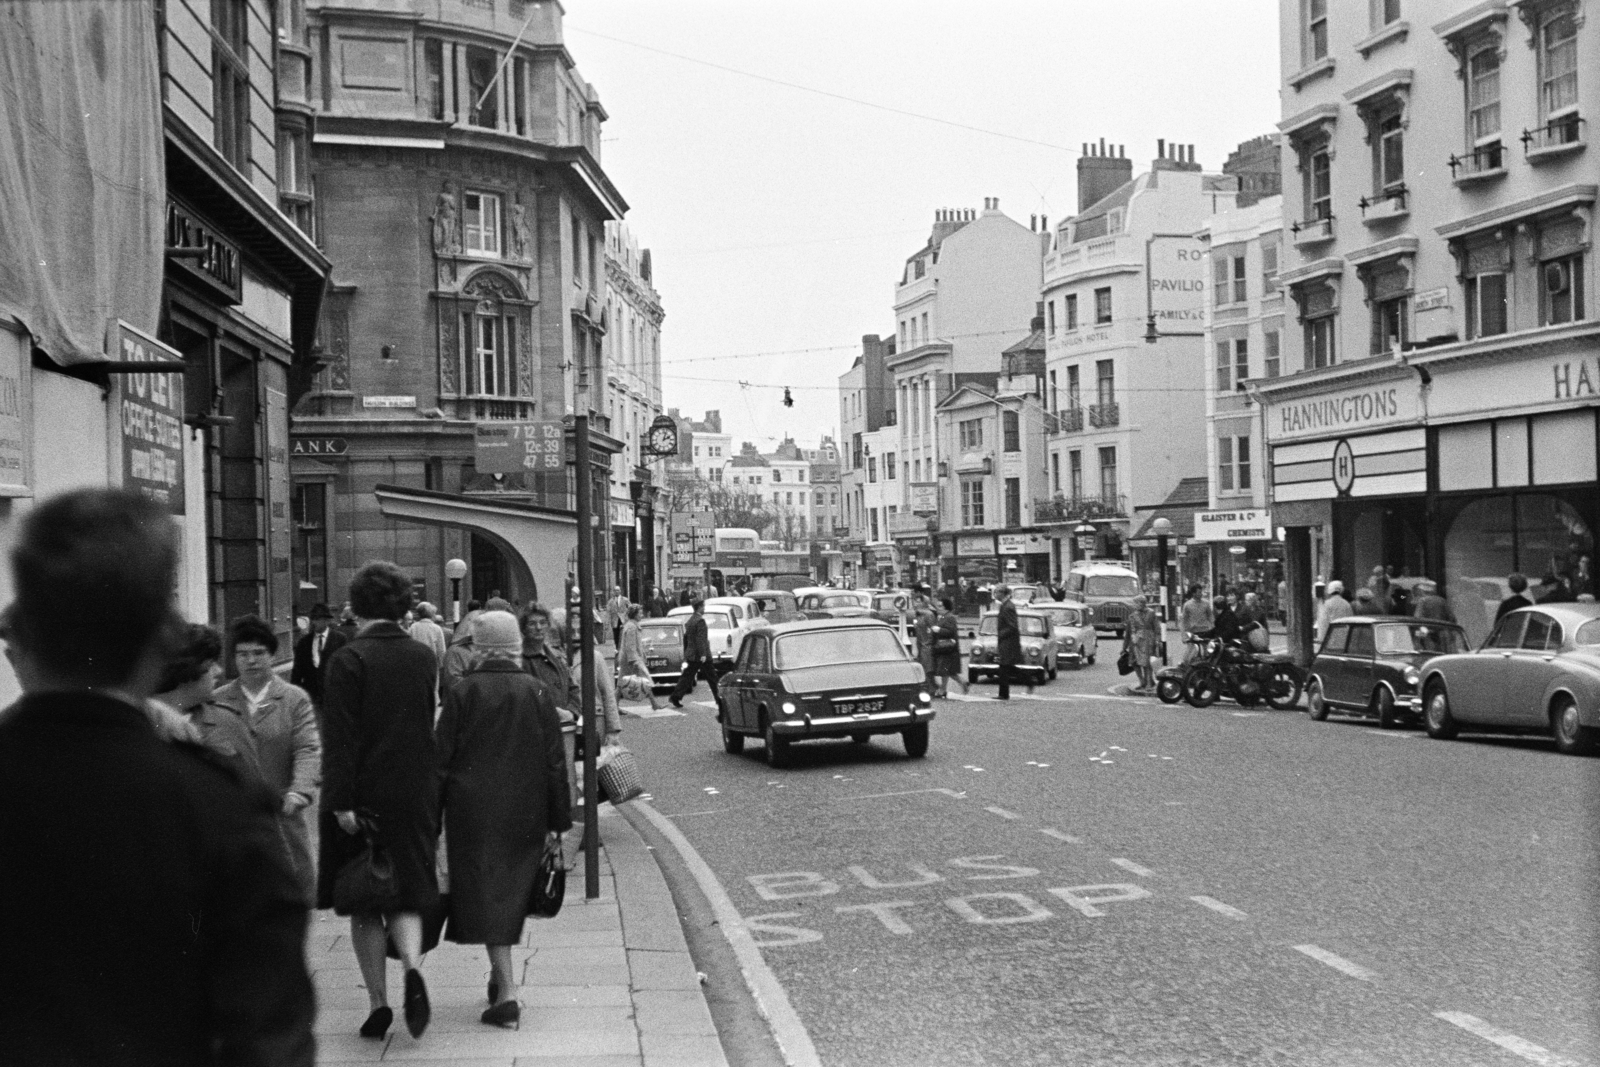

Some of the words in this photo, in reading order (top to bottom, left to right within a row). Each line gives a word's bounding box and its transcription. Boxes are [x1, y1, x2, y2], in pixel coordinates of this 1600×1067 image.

[1152, 279, 1204, 292] PAVILIO
[1086, 332, 1109, 342] HOTEL
[1553, 358, 1600, 399] HA
[1282, 389, 1397, 432] HANNINGTONS
[513, 426, 520, 439] 7
[524, 425, 536, 439] 12
[542, 425, 560, 438] 12a
[545, 440, 559, 453] 39
[523, 454, 537, 468] 47
[544, 454, 559, 468] 55
[1339, 456, 1348, 478] H
[1202, 513, 1237, 522] GLAISTER
[1239, 513, 1245, 521] &
[1227, 528, 1265, 537] CHEMISTS
[834, 703, 855, 714] TBP
[745, 855, 1041, 901] BUS
[743, 883, 1154, 948] STOP
